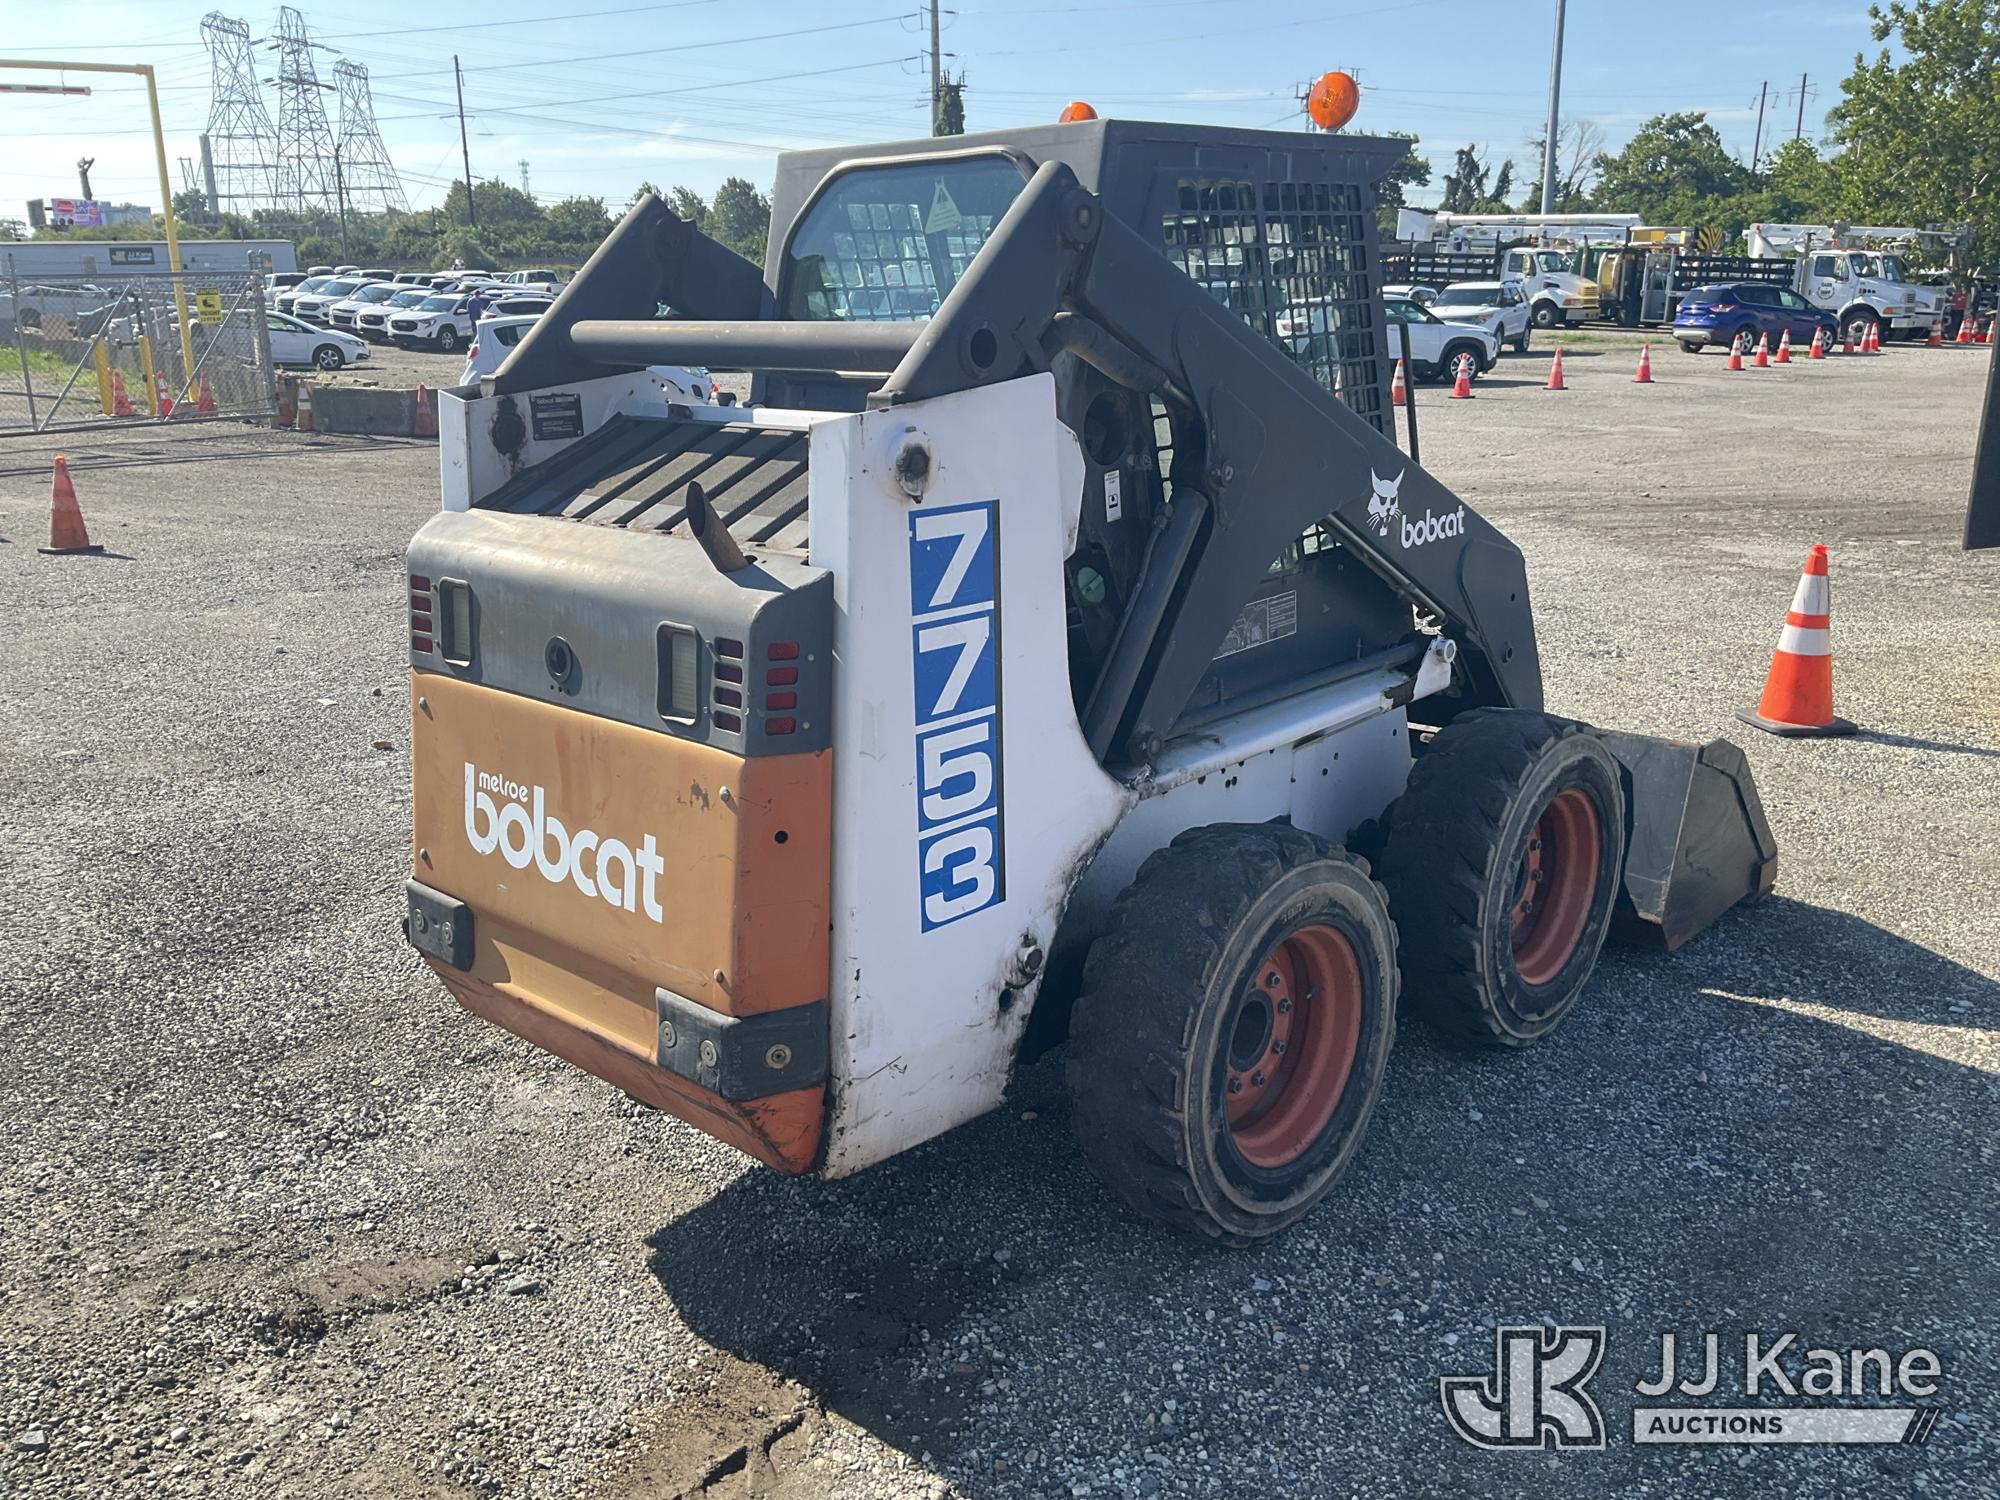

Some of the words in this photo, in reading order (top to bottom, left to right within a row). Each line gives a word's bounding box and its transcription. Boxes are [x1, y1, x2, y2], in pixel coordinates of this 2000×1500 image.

[1401, 505, 1465, 549] bobcat
[914, 508, 996, 924] 7753
[478, 771, 528, 804] melroe
[465, 762, 665, 924] bobcat
